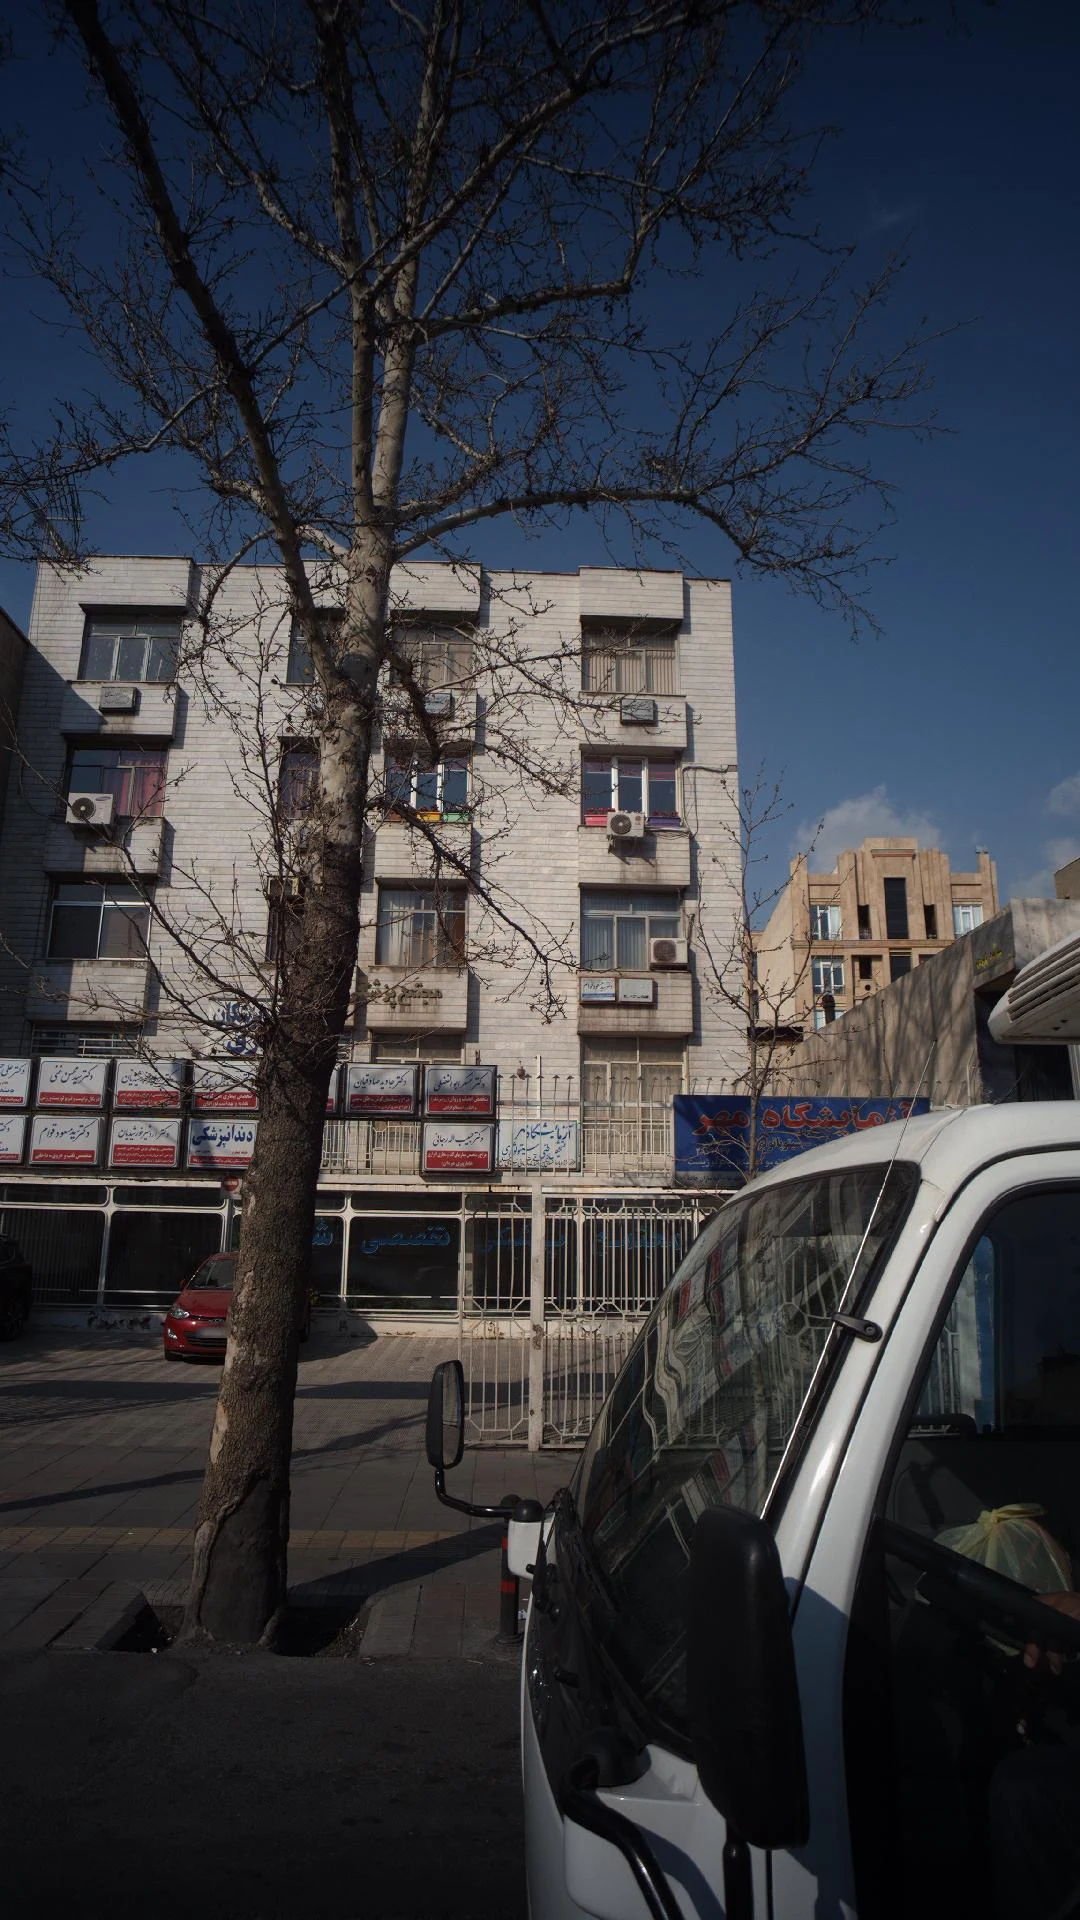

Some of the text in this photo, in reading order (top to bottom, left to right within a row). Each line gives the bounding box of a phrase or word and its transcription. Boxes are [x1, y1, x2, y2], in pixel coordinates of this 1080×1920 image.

[81, 1064, 98, 1081] دکتر
[393, 1070, 410, 1089] دکتر
[471, 1071, 489, 1091] دکتر
[73, 1119, 97, 1142] دکتر
[156, 1123, 174, 1140] دکتر
[691, 1110, 750, 1136] مهر
[192, 1124, 253, 1148] دندانپزشکی
[471, 1126, 489, 1145] دکتر
